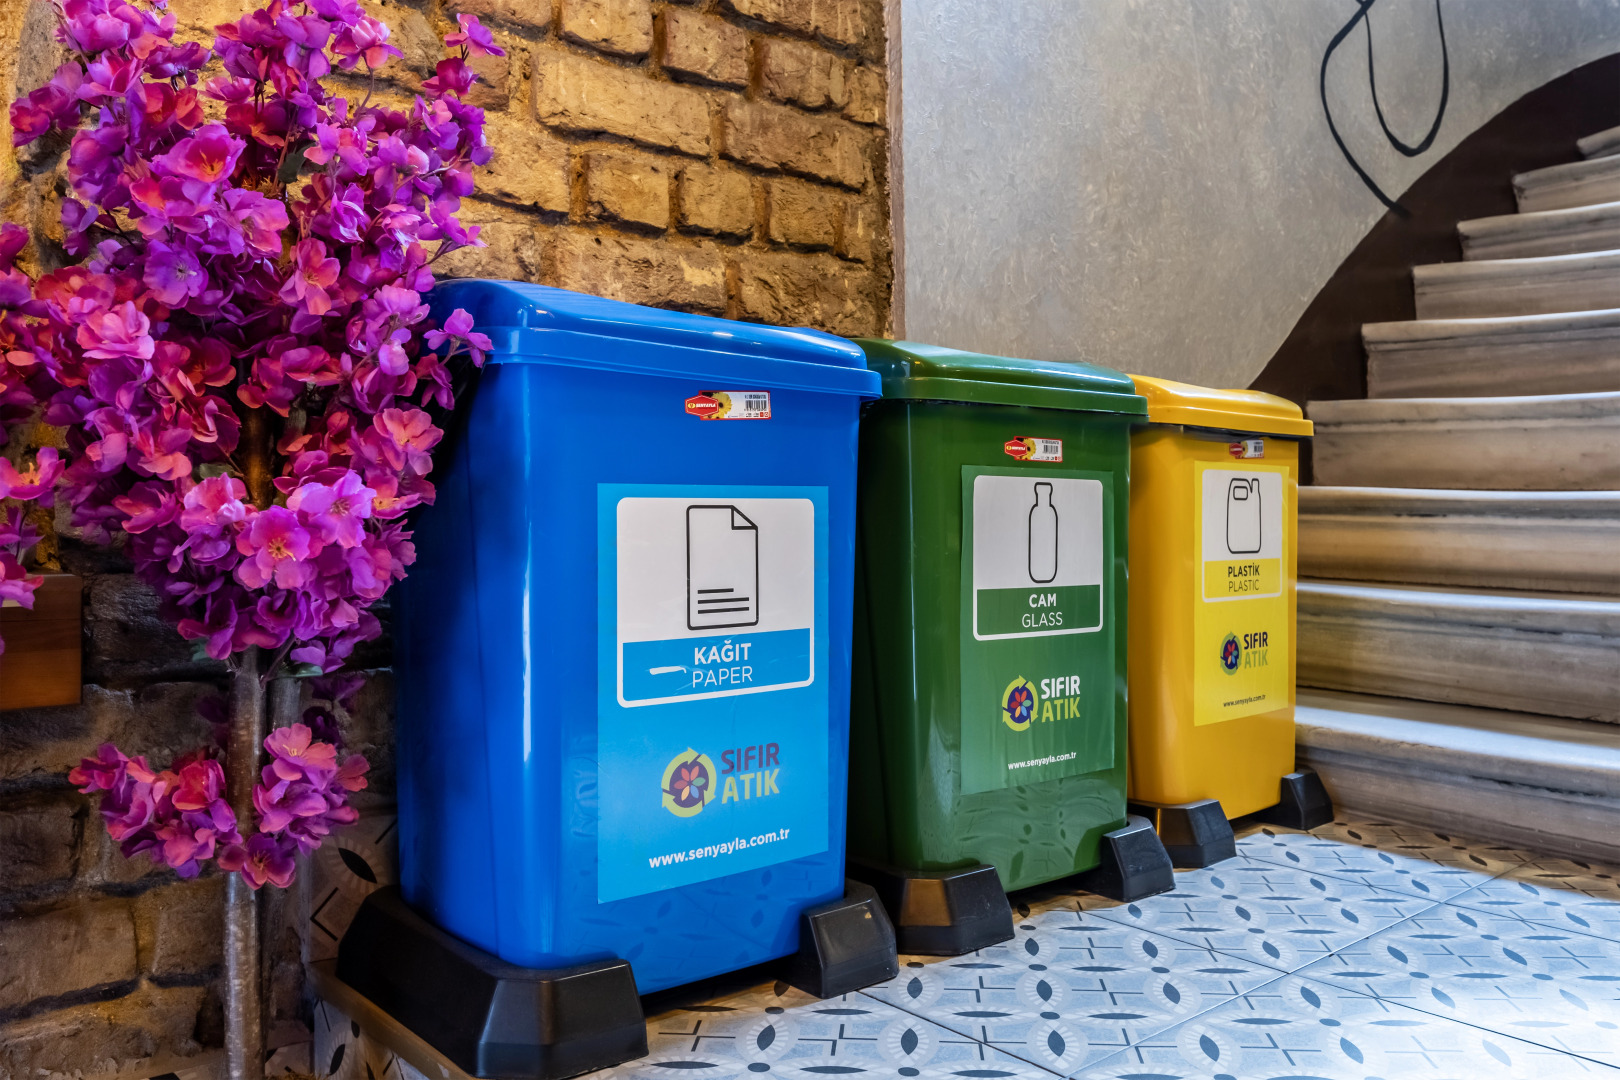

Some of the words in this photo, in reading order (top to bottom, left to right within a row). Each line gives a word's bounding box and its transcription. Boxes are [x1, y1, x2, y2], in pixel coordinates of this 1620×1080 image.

[1228, 563, 1260, 577] PLASTİK
[1229, 579, 1260, 592] PLASTIC
[1029, 594, 1057, 608] CAM
[1022, 612, 1063, 628] GLASS
[1244, 632, 1268, 650] SIFIR
[695, 640, 752, 665] KAĞIT
[1244, 649, 1268, 669] ATIK
[692, 665, 754, 688] PAPER
[1040, 675, 1081, 700] SIFIR
[1041, 697, 1081, 723] ATIK
[721, 742, 780, 775] SIFIR
[1007, 751, 1077, 770] www.senyayla.com.tr
[721, 768, 780, 804] ATIK
[648, 826, 790, 869] www.senyayla.com.tr
